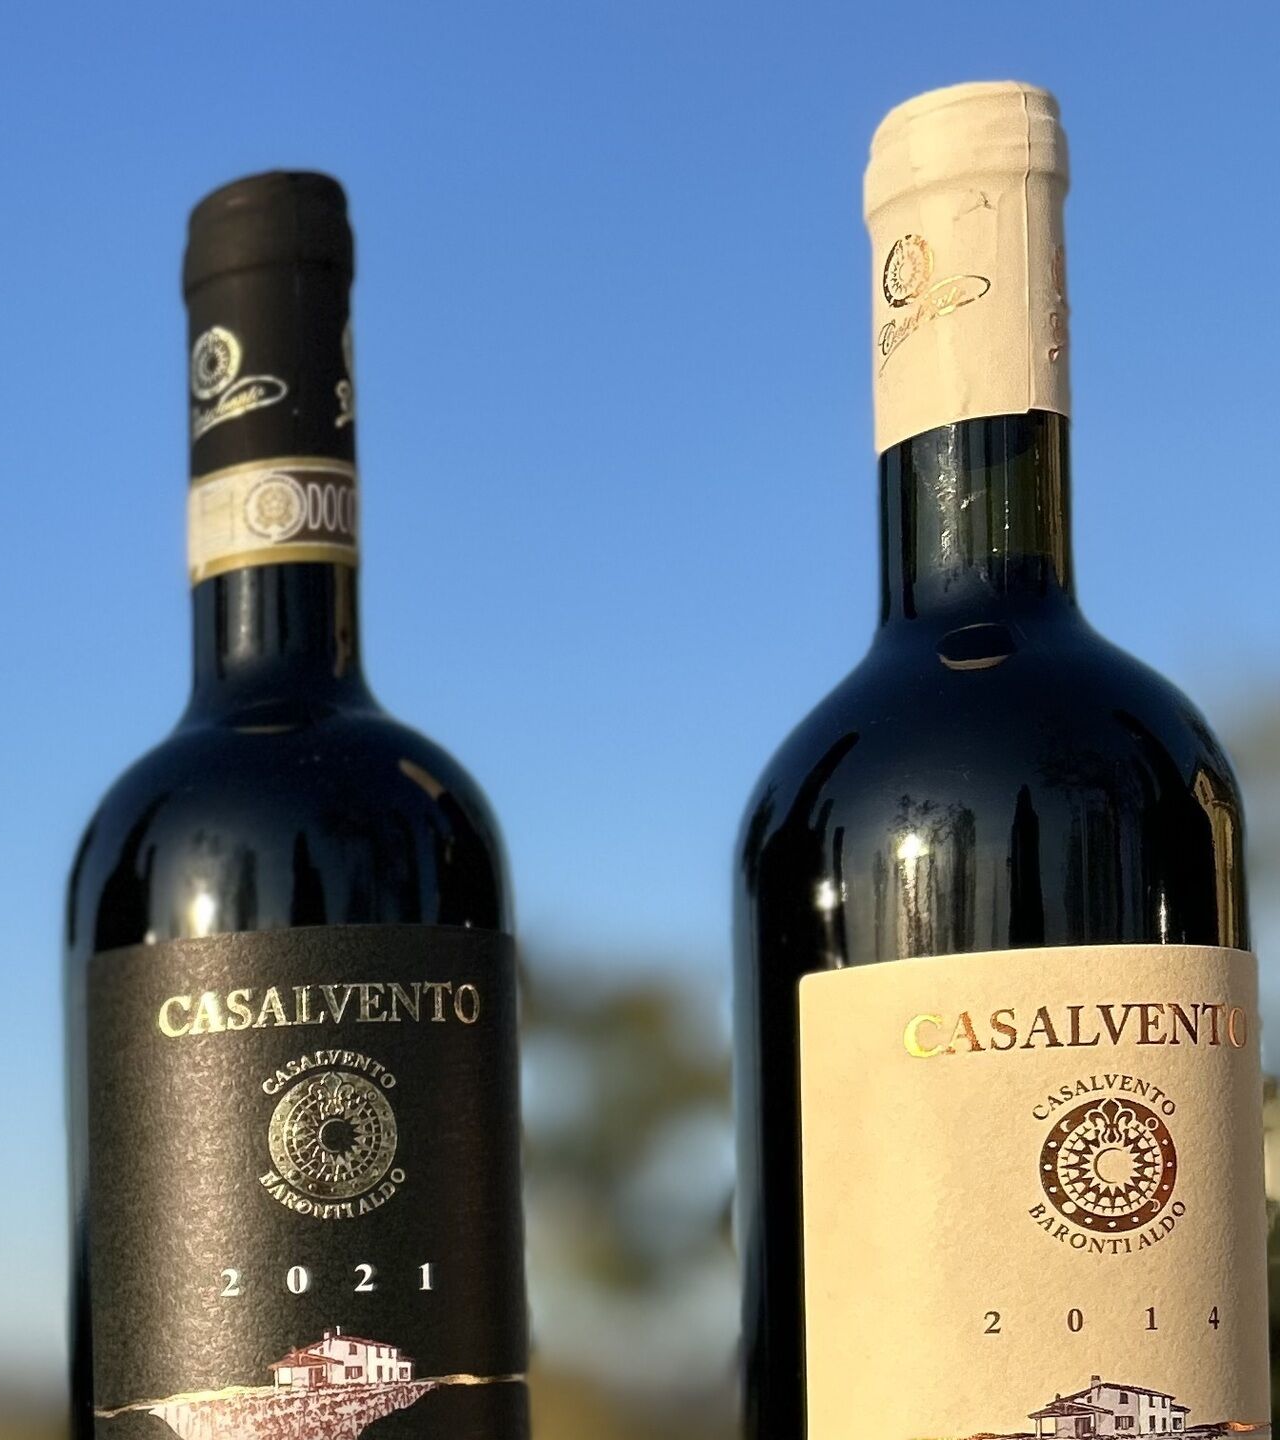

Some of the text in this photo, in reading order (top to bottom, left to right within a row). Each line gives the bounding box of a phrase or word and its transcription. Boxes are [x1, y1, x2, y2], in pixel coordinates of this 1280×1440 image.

[158, 982, 481, 1037] CASALVENTO
[902, 1002, 1248, 1058] CASALVENTO
[261, 1049, 397, 1095] CASALVENTO
[1031, 1073, 1177, 1121] CASALVENTO
[258, 1166, 407, 1219] BARONTI ALDO
[1027, 1200, 1187, 1255] BARONTI ALDO
